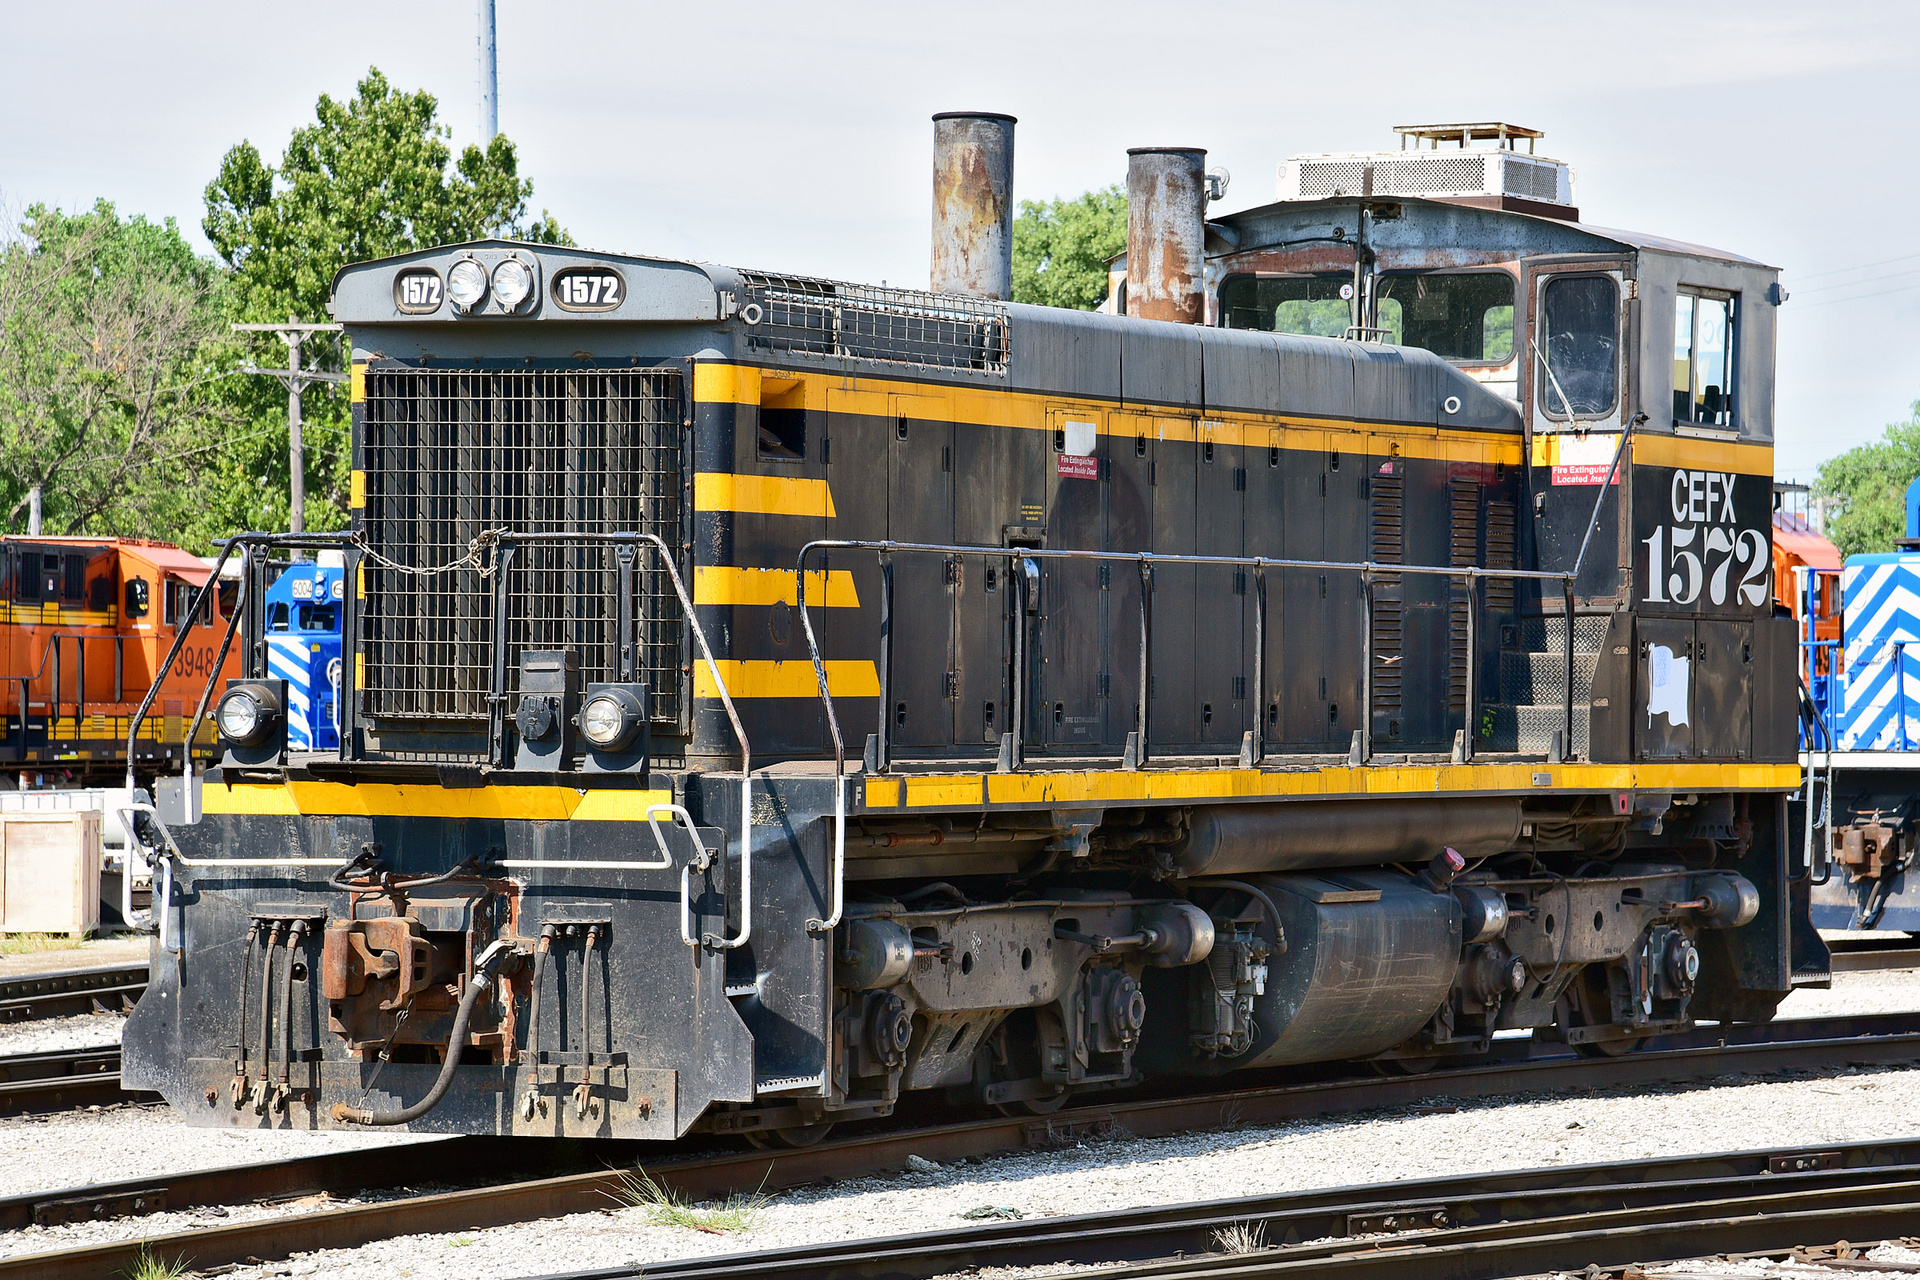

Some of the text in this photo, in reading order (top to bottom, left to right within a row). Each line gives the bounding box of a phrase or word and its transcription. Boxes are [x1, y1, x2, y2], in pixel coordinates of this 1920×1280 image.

[401, 276, 441, 304] 1572
[560, 276, 619, 303] 1572
[1057, 465, 1074, 473] Located
[1069, 456, 1094, 466] Extinguisher
[1552, 466, 1619, 474] Fire Extinguishr
[1557, 475, 1588, 483] Located
[1671, 469, 1736, 523] CEFX
[1642, 524, 1768, 607] 1572
[293, 582, 312, 596] 6004
[174, 646, 214, 677] 3948
[855, 786, 862, 806] F
